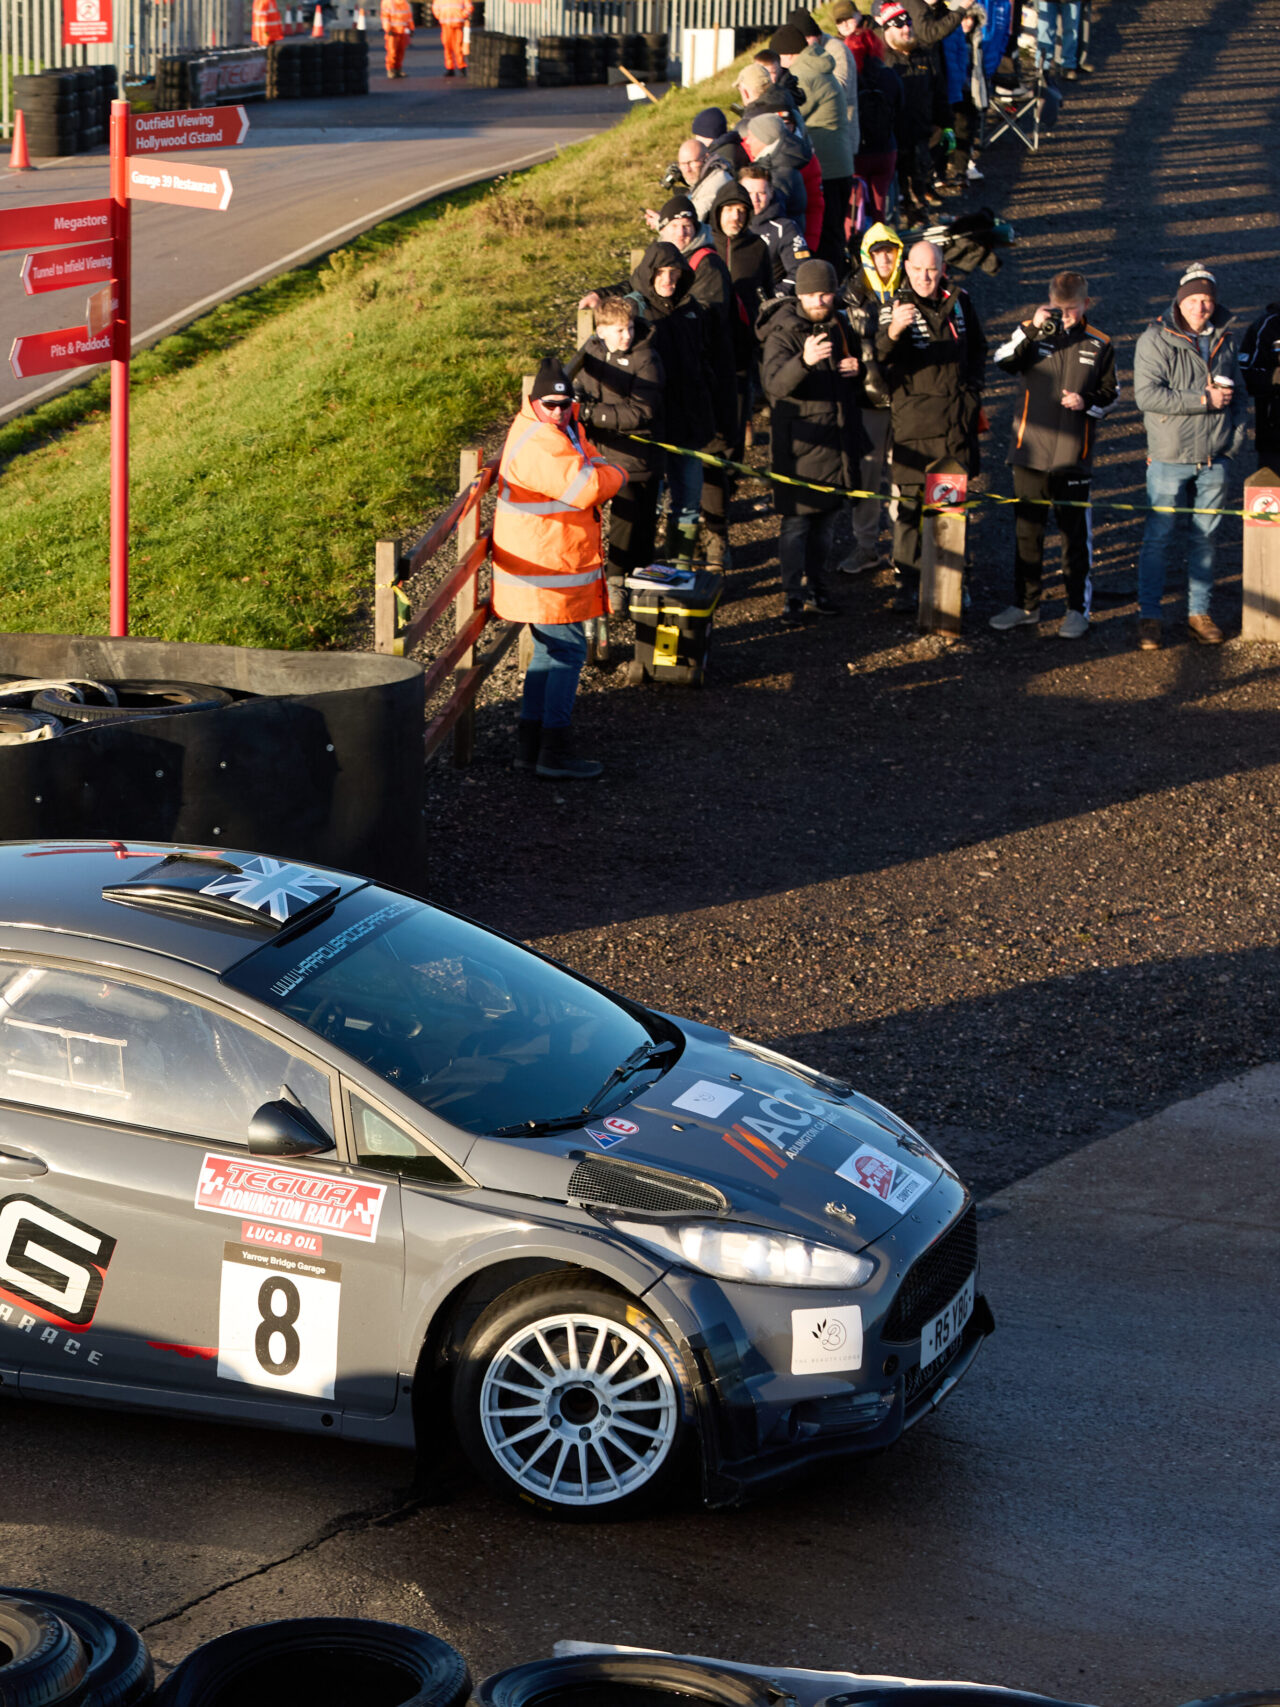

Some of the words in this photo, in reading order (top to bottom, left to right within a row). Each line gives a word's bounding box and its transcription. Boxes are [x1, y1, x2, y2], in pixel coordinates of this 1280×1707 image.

[136, 115, 174, 131] Outfield
[177, 113, 214, 129] Viewing
[136, 132, 187, 149] Hollywood
[131, 170, 160, 189] Garage
[173, 175, 217, 194] Restaurant
[53, 215, 108, 231] Megastore
[32, 265, 55, 280] Tunnel
[55, 264, 63, 276] to
[63, 258, 85, 274] Infield
[86, 255, 112, 270] Viewing
[50, 343, 67, 357] Pits
[67, 342, 75, 354] &
[75, 336, 110, 353] Paddock
[608, 1119, 635, 1132] E
[227, 1163, 359, 1208] TEGIWA
[221, 1188, 301, 1222] DONINGTON
[303, 1203, 353, 1230] RALLY
[246, 1225, 294, 1245] LUCAS
[294, 1236, 318, 1251] OIL
[270, 1256, 297, 1269] Bridge
[297, 1262, 326, 1275] Garage
[254, 1275, 301, 1376] 8
[934, 1311, 950, 1352] R5
